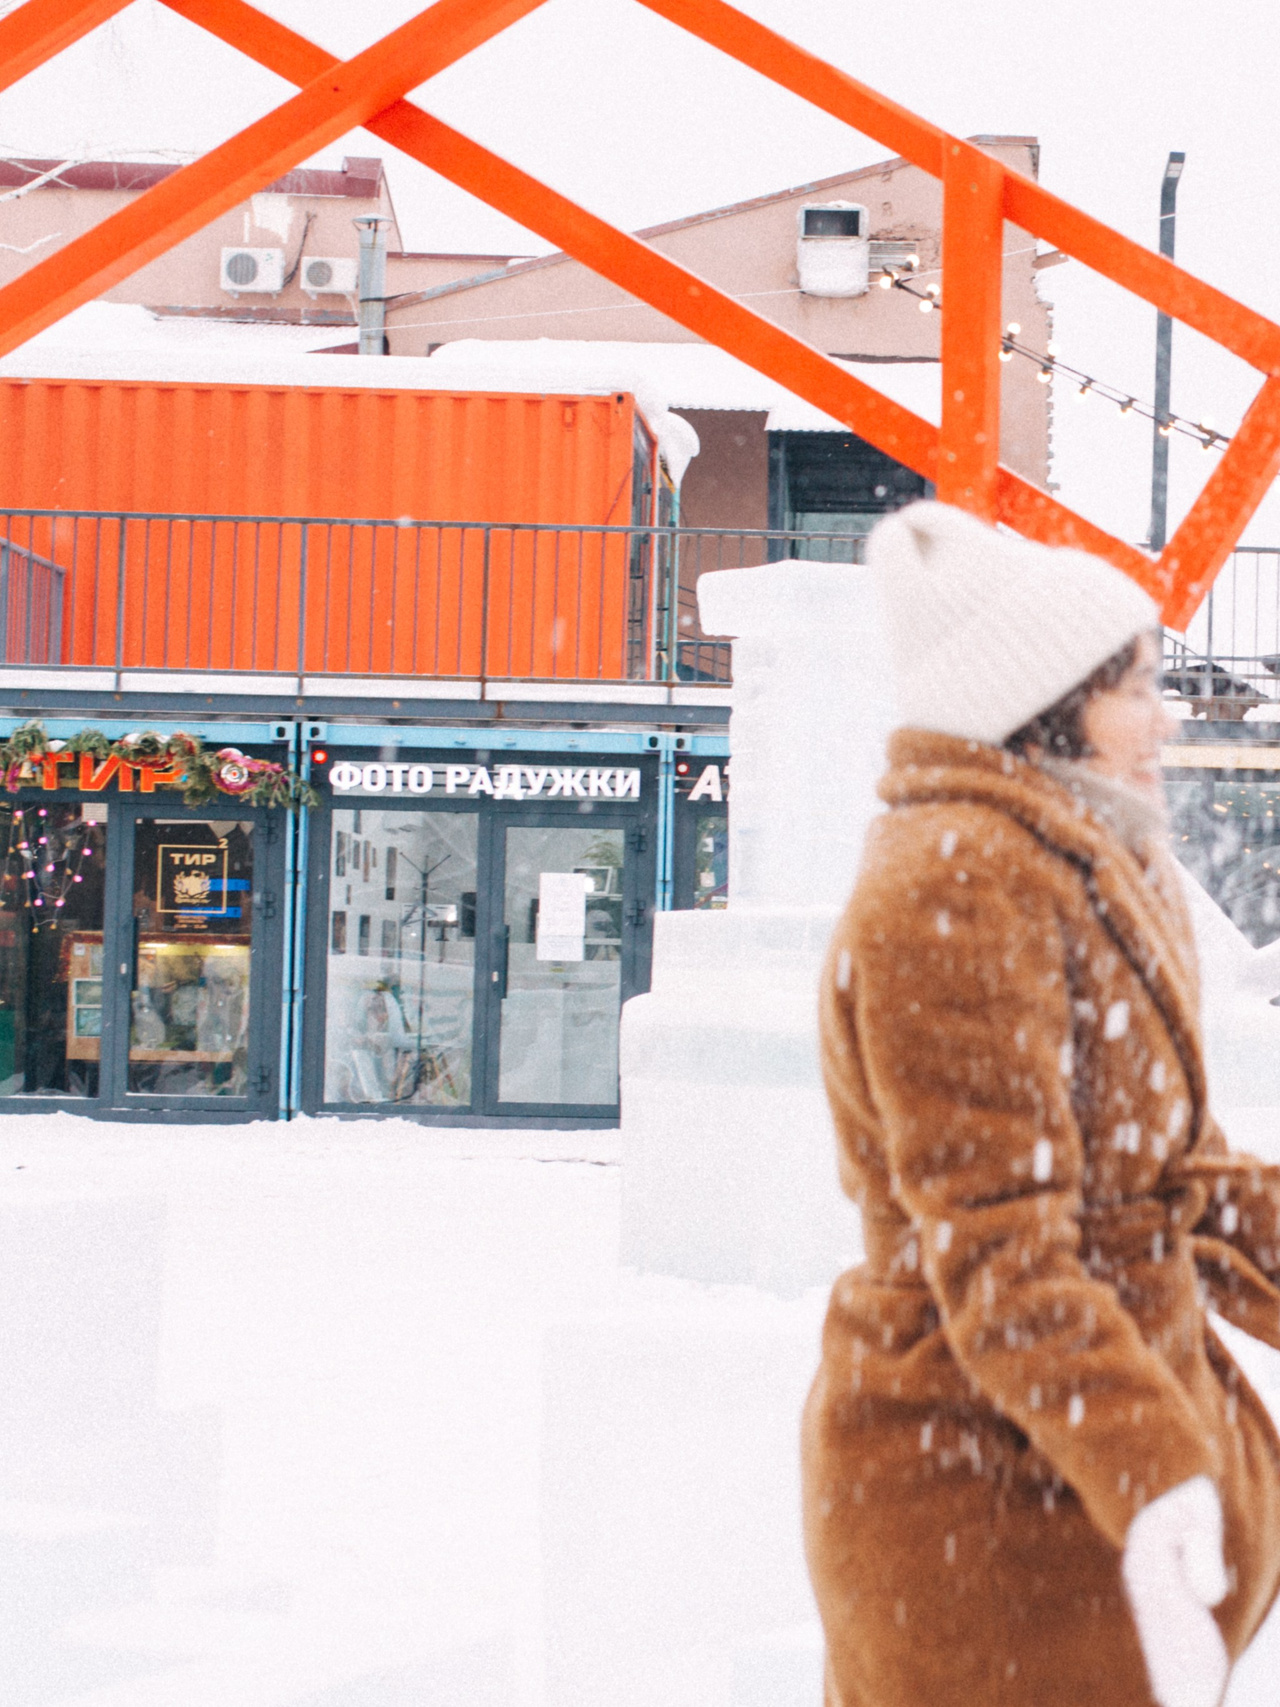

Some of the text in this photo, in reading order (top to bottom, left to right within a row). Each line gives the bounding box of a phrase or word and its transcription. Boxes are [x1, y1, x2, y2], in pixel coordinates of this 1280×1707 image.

[328, 762, 641, 800] ФОТО РАДУЖКИ
[170, 853, 216, 865] ТИР
